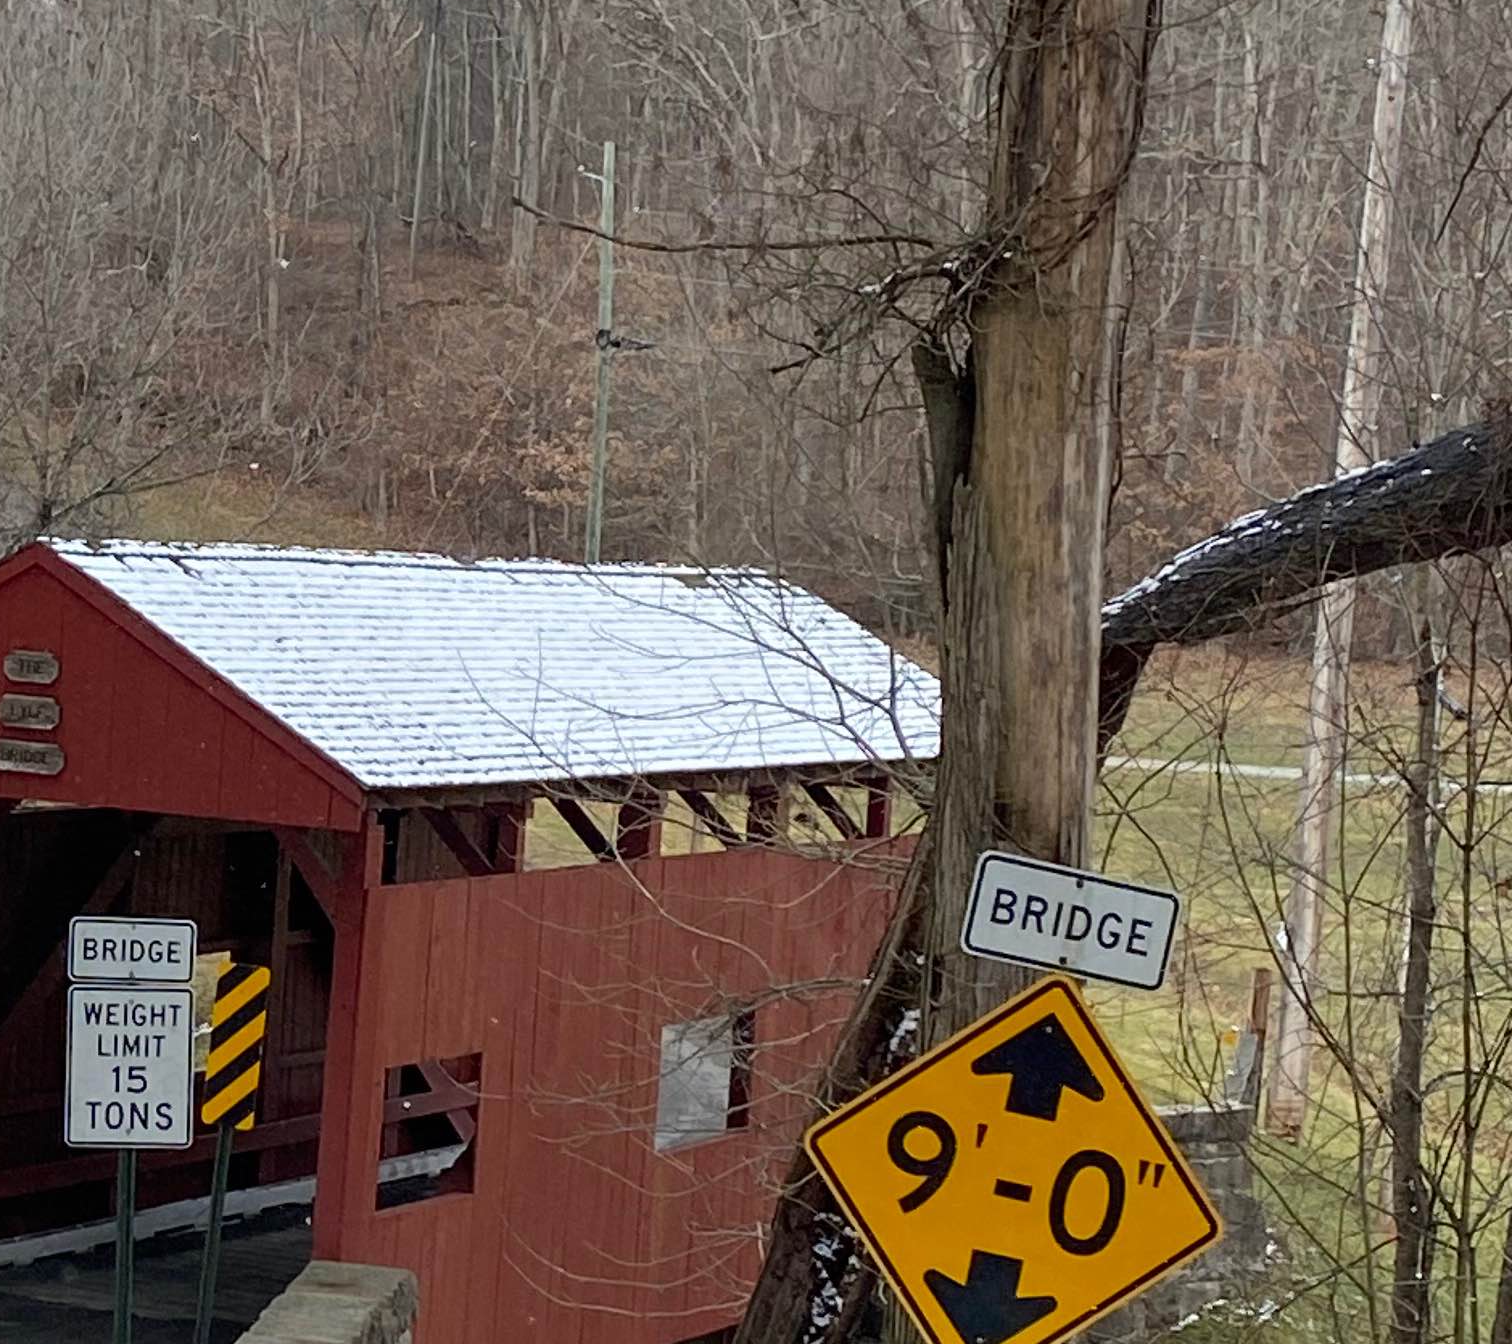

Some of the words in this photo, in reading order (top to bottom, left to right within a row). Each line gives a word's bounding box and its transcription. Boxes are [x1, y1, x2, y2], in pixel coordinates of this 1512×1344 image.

[989, 888, 1155, 957] BRIDGE
[82, 937, 182, 964] BRIDGE
[83, 1002, 182, 1027] WEIGHT
[97, 1034, 166, 1058] LIMIT
[111, 1065, 148, 1094] 15
[85, 1101, 174, 1131] TONS
